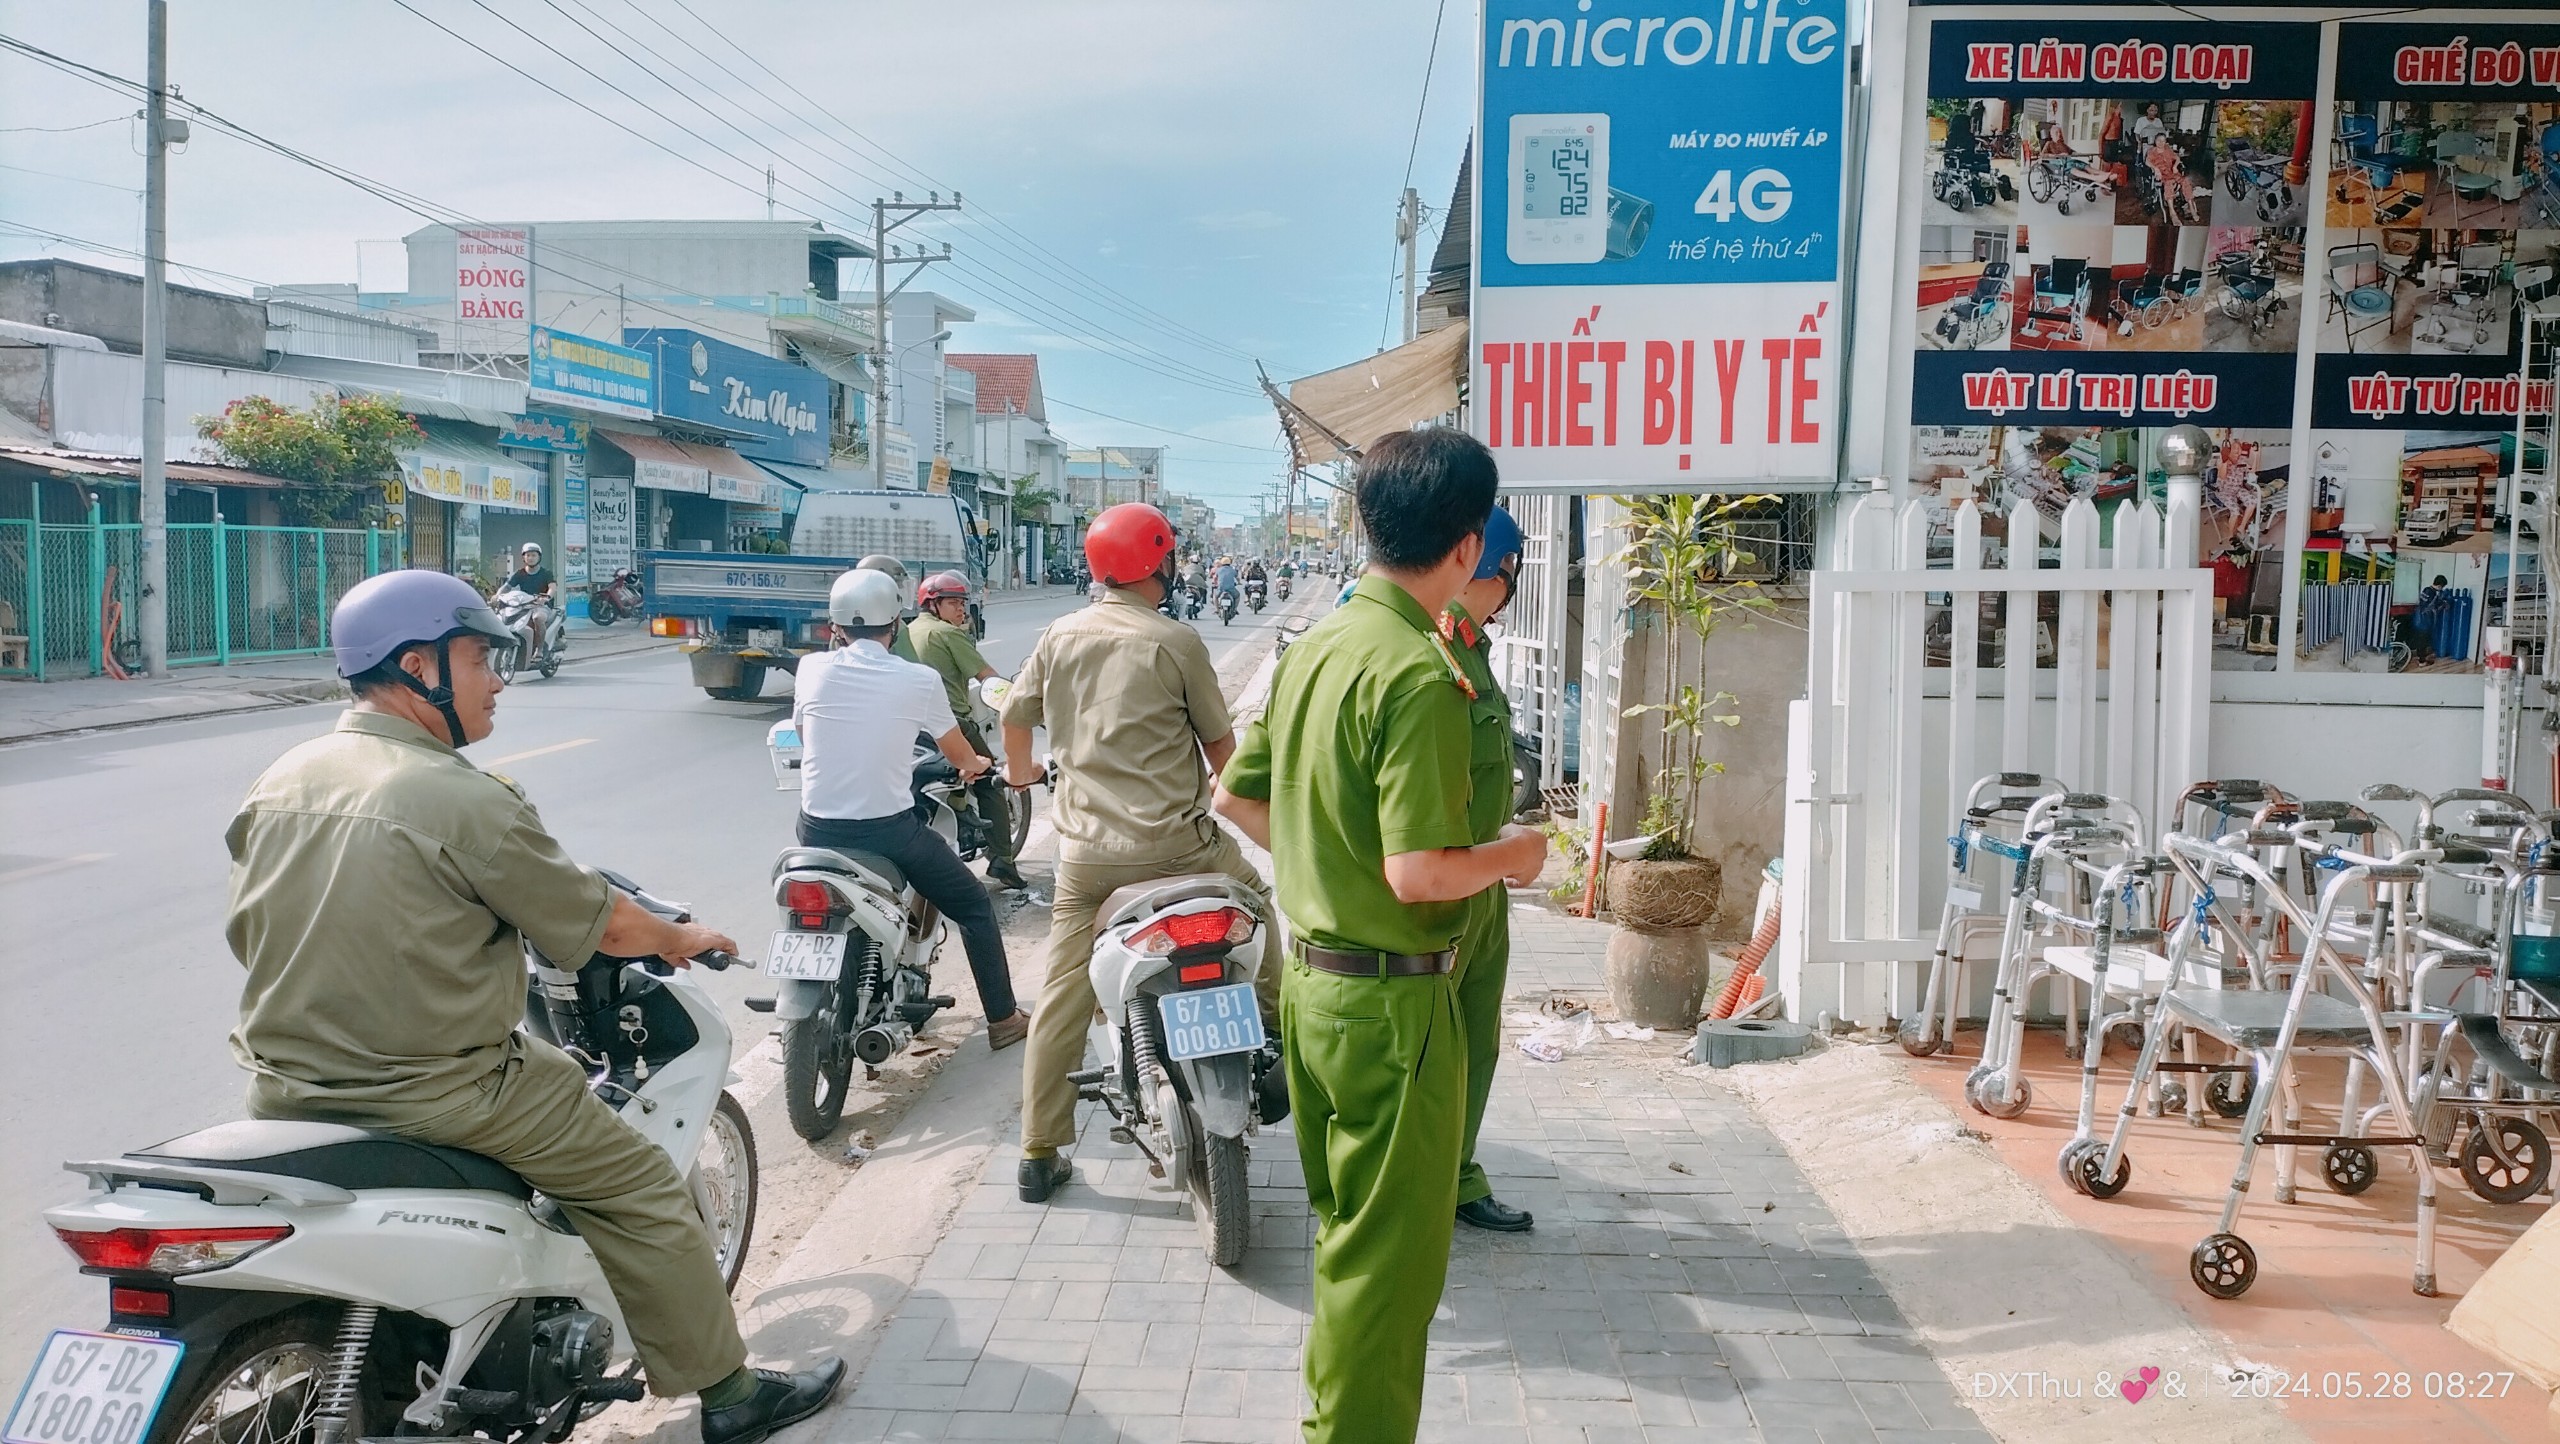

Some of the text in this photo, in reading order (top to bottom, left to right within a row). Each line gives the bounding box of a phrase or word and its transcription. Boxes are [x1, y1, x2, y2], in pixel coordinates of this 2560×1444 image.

[1498, 0, 1837, 67] microlife
[1968, 39, 2251, 87] XE LĂN CÁC LOẠI
[2396, 38, 2467, 83] GHẾ
[2472, 43, 2523, 84] BÔ
[1669, 127, 1828, 148] MÁY ĐO HUYẾT ÁP
[1552, 149, 1589, 170] 124
[1558, 173, 1588, 194] 75
[1694, 168, 1793, 223] 4G
[1560, 196, 1588, 216] 82
[459, 242, 473, 255] SÁT
[477, 244, 498, 256] HẠCH
[515, 245, 525, 255] XE
[1668, 236, 1711, 260] thế
[1712, 239, 1744, 263] hệ
[1751, 236, 1792, 259] thứ
[459, 260, 526, 288] ĐỒNG
[461, 293, 525, 319] BẰNG
[1483, 302, 1829, 470] THIẾT BỊ Y TẾ
[1965, 369, 2214, 416] VẬT LÍ TRỊ LIỆU
[2349, 373, 2409, 418] VẬT
[2415, 374, 2460, 413] TƯ
[721, 376, 818, 437] Kim Ngân
[422, 463, 442, 493] TRÀ
[492, 476, 512, 501] 1985
[592, 488, 627, 498] Beauty Salon
[592, 499, 628, 522] Như Ý
[727, 572, 787, 588] 67C-156.42
[782, 935, 835, 955] 67-D2
[772, 956, 836, 977] 344.17
[1175, 990, 1243, 1024] 67-B1
[1174, 1017, 1256, 1054] 008.01
[115, 1327, 161, 1338] HONDA
[51, 1340, 158, 1395] 67-D2
[23, 1391, 144, 1444] 180.60
